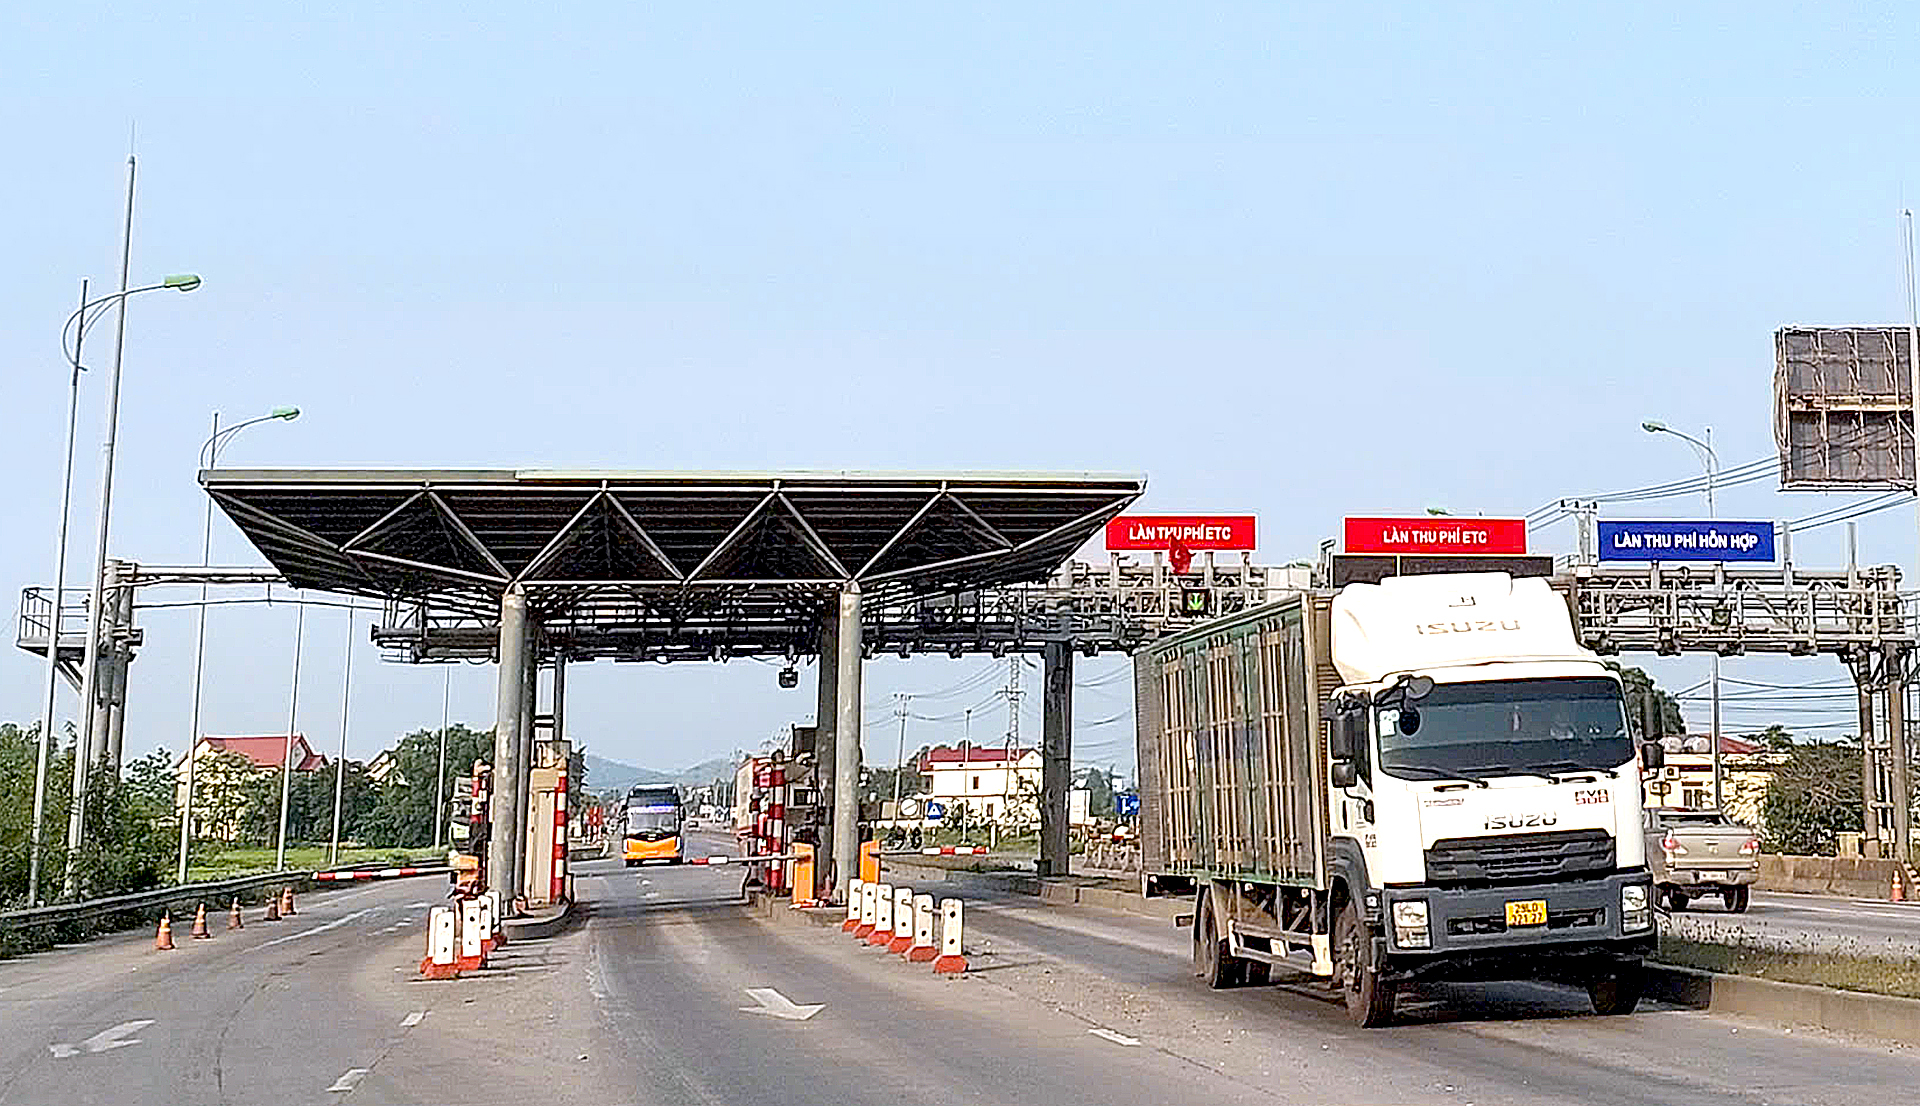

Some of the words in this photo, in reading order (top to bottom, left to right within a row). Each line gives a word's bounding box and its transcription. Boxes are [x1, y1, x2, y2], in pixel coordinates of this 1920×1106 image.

[1129, 523, 1155, 540] LÀN
[1157, 526, 1182, 540] THU
[1184, 523, 1205, 540] PHÍ
[1206, 526, 1232, 540] ETC
[1383, 526, 1409, 544] LÀN
[1411, 530, 1437, 544] THU
[1439, 526, 1460, 544] PHÍ
[1463, 530, 1487, 544] ETC
[1614, 530, 1642, 548] LÀN
[1644, 534, 1671, 548] THU
[1674, 531, 1697, 548] PHÍ
[1699, 529, 1728, 548] HỖN
[1731, 533, 1758, 552] HỢP
[1416, 620, 1520, 635] ISUZU
[1484, 811, 1557, 830] ISUZU
